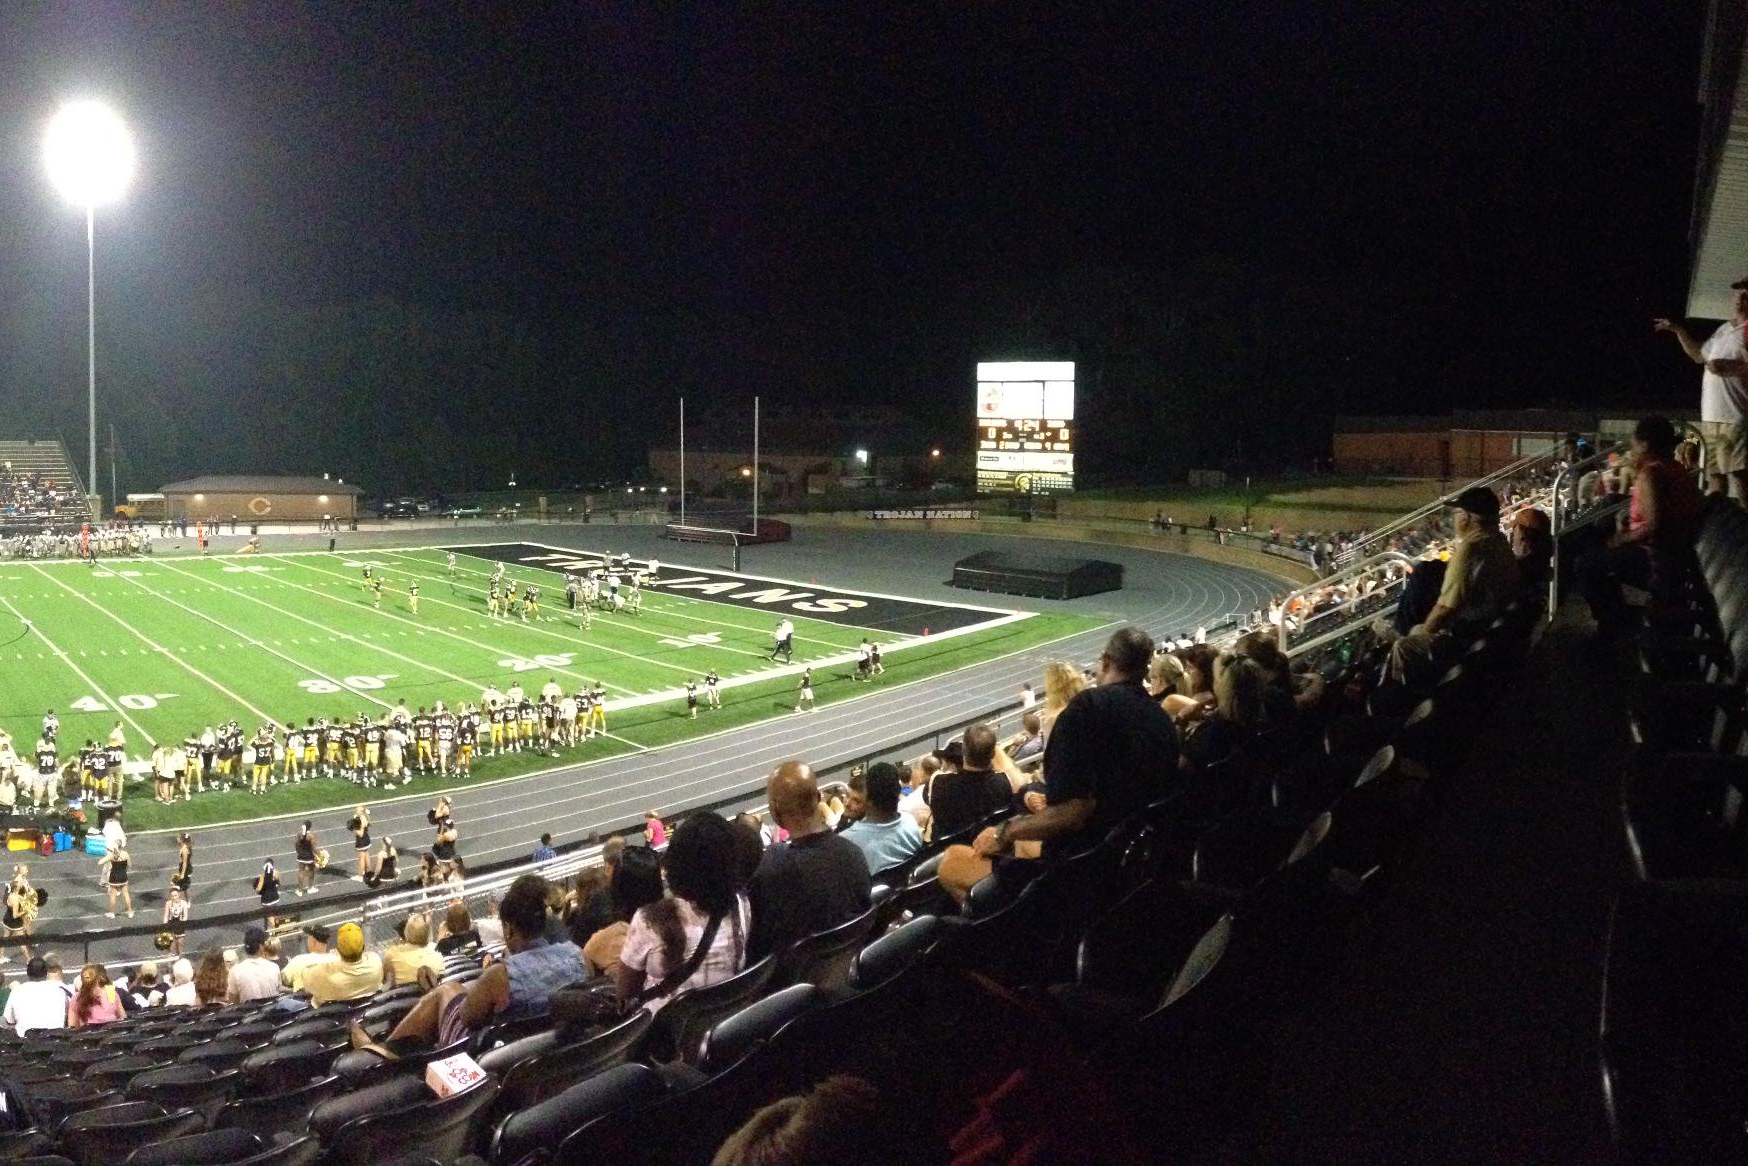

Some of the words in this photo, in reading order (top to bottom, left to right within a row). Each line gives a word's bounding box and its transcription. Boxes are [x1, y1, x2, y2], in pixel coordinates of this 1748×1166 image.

[874, 510, 924, 519] TROJAN
[926, 510, 972, 519] NATION
[69, 694, 158, 711] 40
